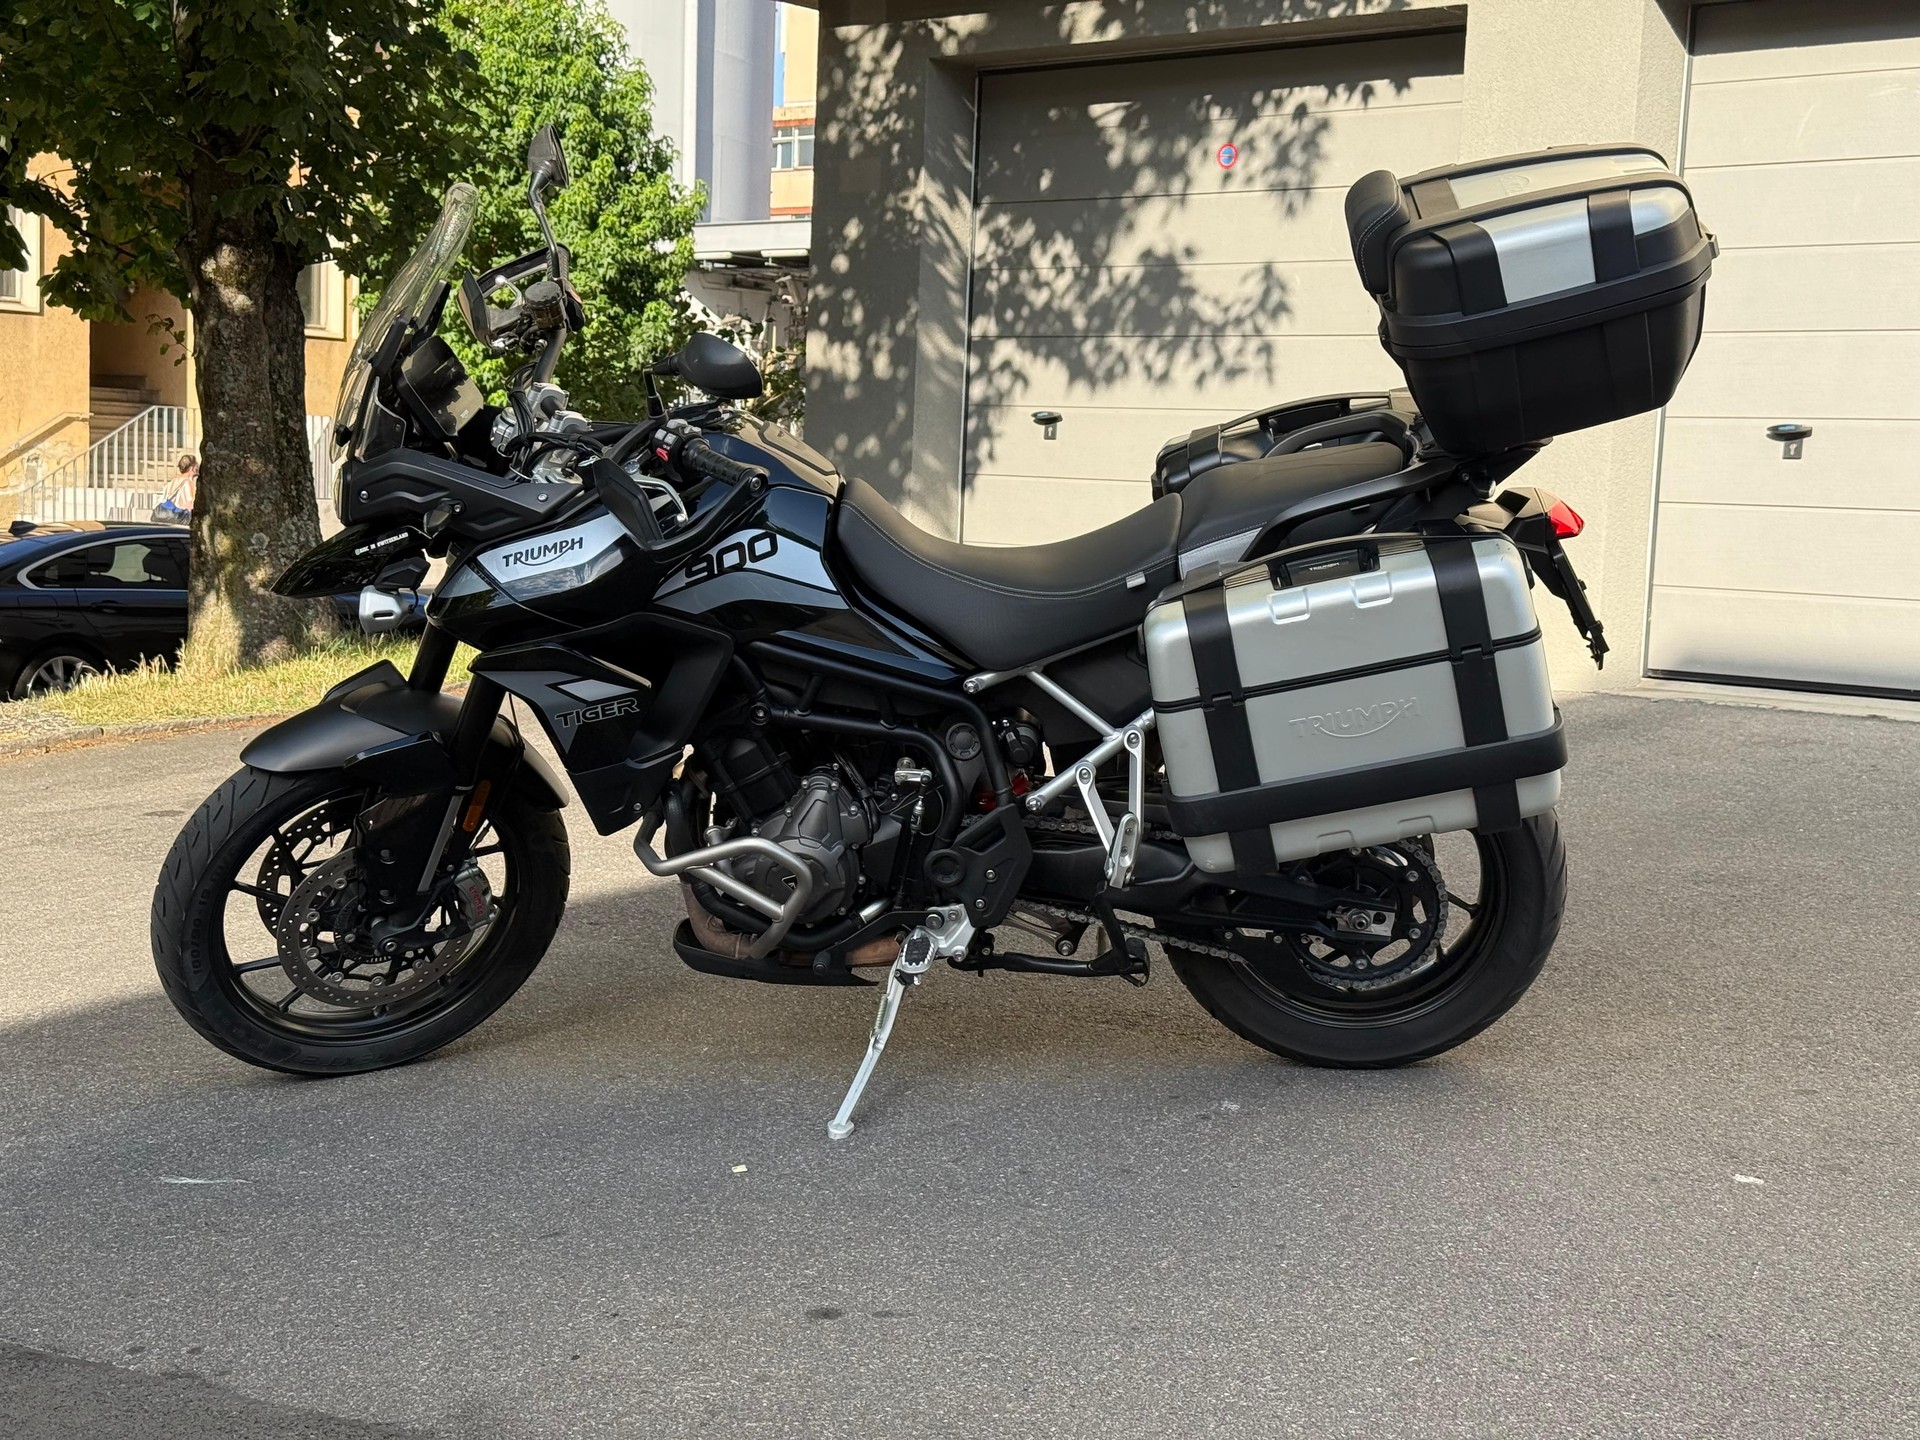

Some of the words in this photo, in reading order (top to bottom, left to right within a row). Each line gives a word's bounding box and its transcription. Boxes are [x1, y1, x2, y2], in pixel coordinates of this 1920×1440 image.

[502, 536, 584, 567] TRIUMPH
[684, 531, 778, 585] 900
[554, 697, 641, 728] TIGER
[1288, 697, 1422, 738] TRIUMPH
